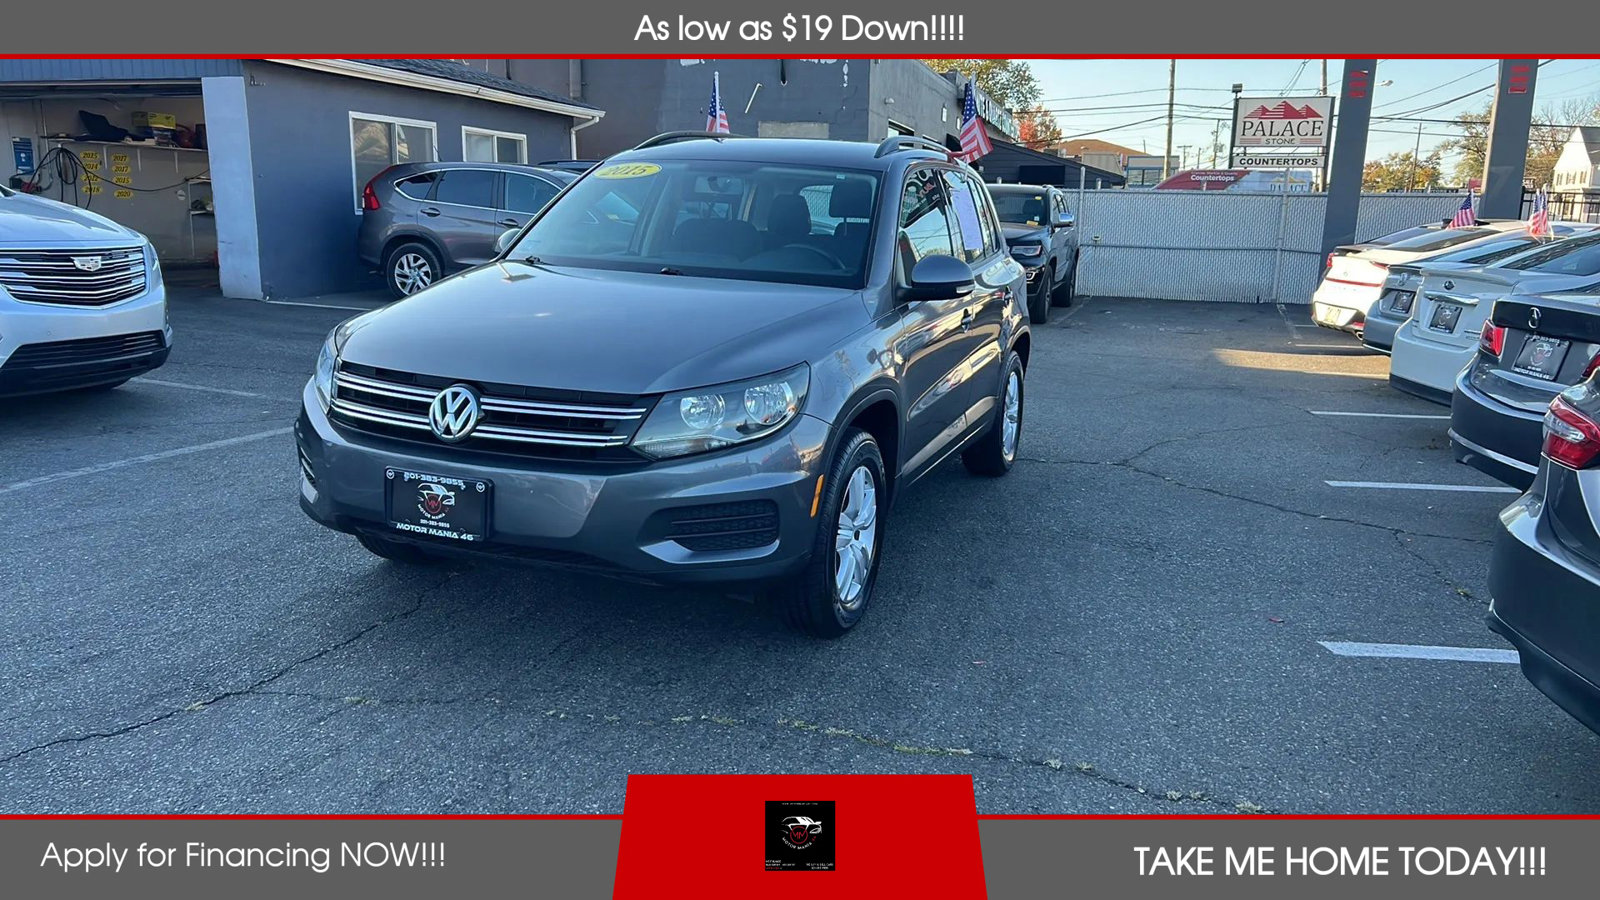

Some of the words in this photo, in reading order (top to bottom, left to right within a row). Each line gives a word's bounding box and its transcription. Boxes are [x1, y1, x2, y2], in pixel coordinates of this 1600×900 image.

[1241, 120, 1324, 137] PALACE
[1239, 158, 1318, 166] COUNTERTOPS
[1190, 174, 1235, 182] Countertops
[396, 523, 427, 534] MOTOR
[428, 528, 459, 539] MANIA
[460, 533, 474, 541] 46
